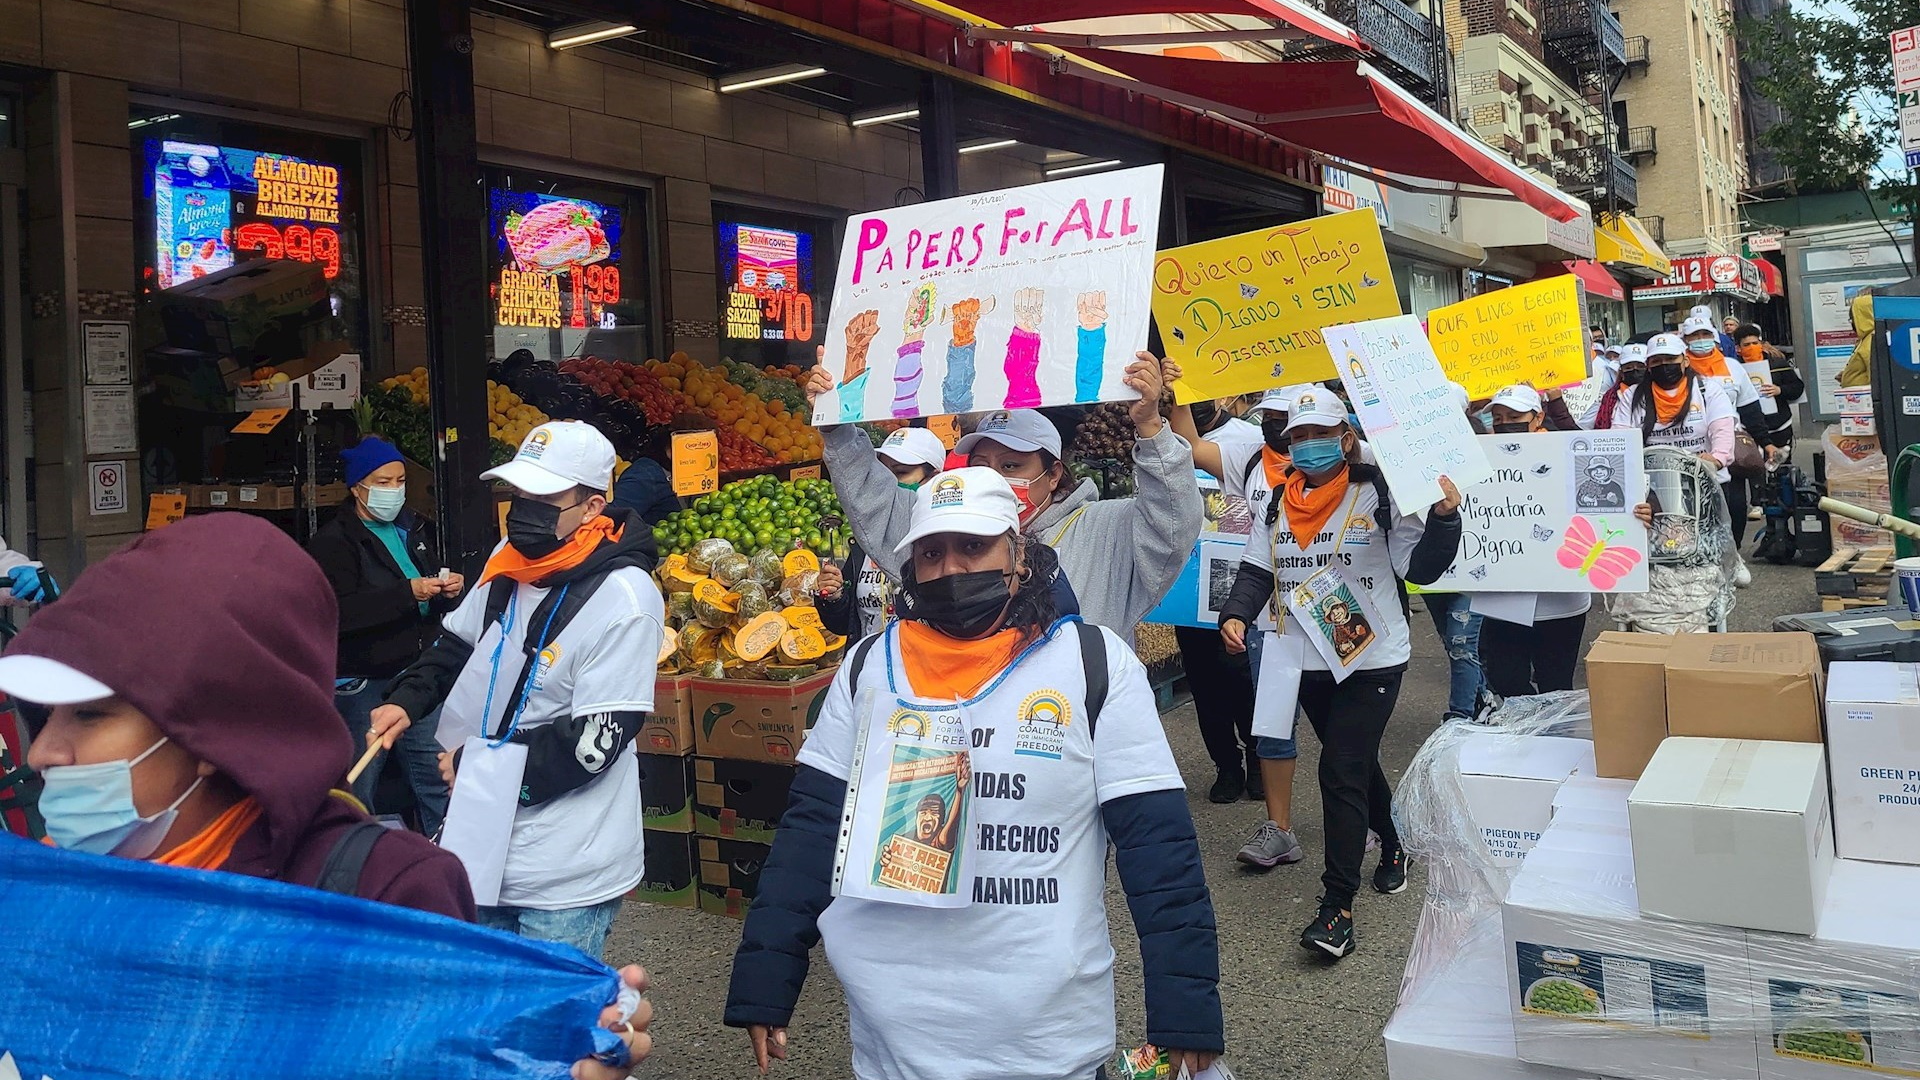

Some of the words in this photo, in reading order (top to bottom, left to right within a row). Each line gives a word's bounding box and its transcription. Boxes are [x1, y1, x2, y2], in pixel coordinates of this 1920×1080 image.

[254, 156, 338, 188] ALMOND
[258, 179, 338, 209] BREEZE
[178, 199, 226, 224] Almond
[256, 202, 307, 220] ALMOND
[310, 208, 339, 224] MILK
[188, 215, 221, 236] Breeze
[852, 218, 985, 285] PAPERS
[1000, 207, 1048, 256] For
[1051, 197, 1138, 246] ALL
[1261, 249, 1286, 268] un
[1267, 227, 1360, 277] Trabajo
[502, 270, 546, 291] GRADE
[549, 274, 559, 292] A
[1153, 256, 1253, 296] Quiero
[1689, 260, 1702, 283] 2
[500, 289, 560, 309] CHICKEN
[730, 292, 757, 309] GOYA
[499, 306, 562, 328] CUTLETS
[600, 312, 616, 329] LB
[727, 307, 761, 324] SAZON
[765, 290, 812, 342] 3/10
[1182, 297, 1280, 357] DIGNO
[1312, 282, 1357, 310] SIN
[1436, 313, 1468, 335] OUR
[1476, 301, 1513, 324] LIVES
[1524, 288, 1567, 311] BEGIN
[727, 323, 761, 339] JUMBO
[763, 329, 776, 340] 6.33
[776, 330, 784, 340] OZ
[1440, 339, 1459, 354] TO
[1472, 330, 1499, 348] END
[1513, 319, 1537, 336] THE
[1545, 311, 1567, 328] DAY
[1469, 345, 1518, 367] BECOME
[1530, 330, 1572, 349] SILENT
[1480, 360, 1521, 378] THINGS
[1528, 351, 1548, 364] THAT
[101, 494, 117, 502] PETS
[931, 497, 963, 506] FREEDOM
[932, 489, 963, 501] COALITION
[1458, 494, 1546, 530] Migratoria
[1462, 530, 1525, 564] Digna
[1311, 567, 1338, 588] COALITION
[1317, 574, 1343, 597] FREEDOM
[757, 722, 795, 733] PLANTAINS
[971, 727, 995, 748] or
[1018, 725, 1065, 738] COALITION
[1016, 740, 1063, 754] FREEDOM
[1032, 735, 1064, 745] IMMIGRANT
[1861, 767, 1904, 781] GREEN
[974, 771, 1026, 801] IDAS
[1902, 783, 1920, 795] 24/
[1486, 828, 1521, 841] PIGEON
[1507, 840, 1521, 850] OZ.
[890, 840, 916, 861] WE
[915, 848, 948, 872] ARE
[1504, 850, 1516, 858] OF
[881, 864, 941, 894] HUMAN
